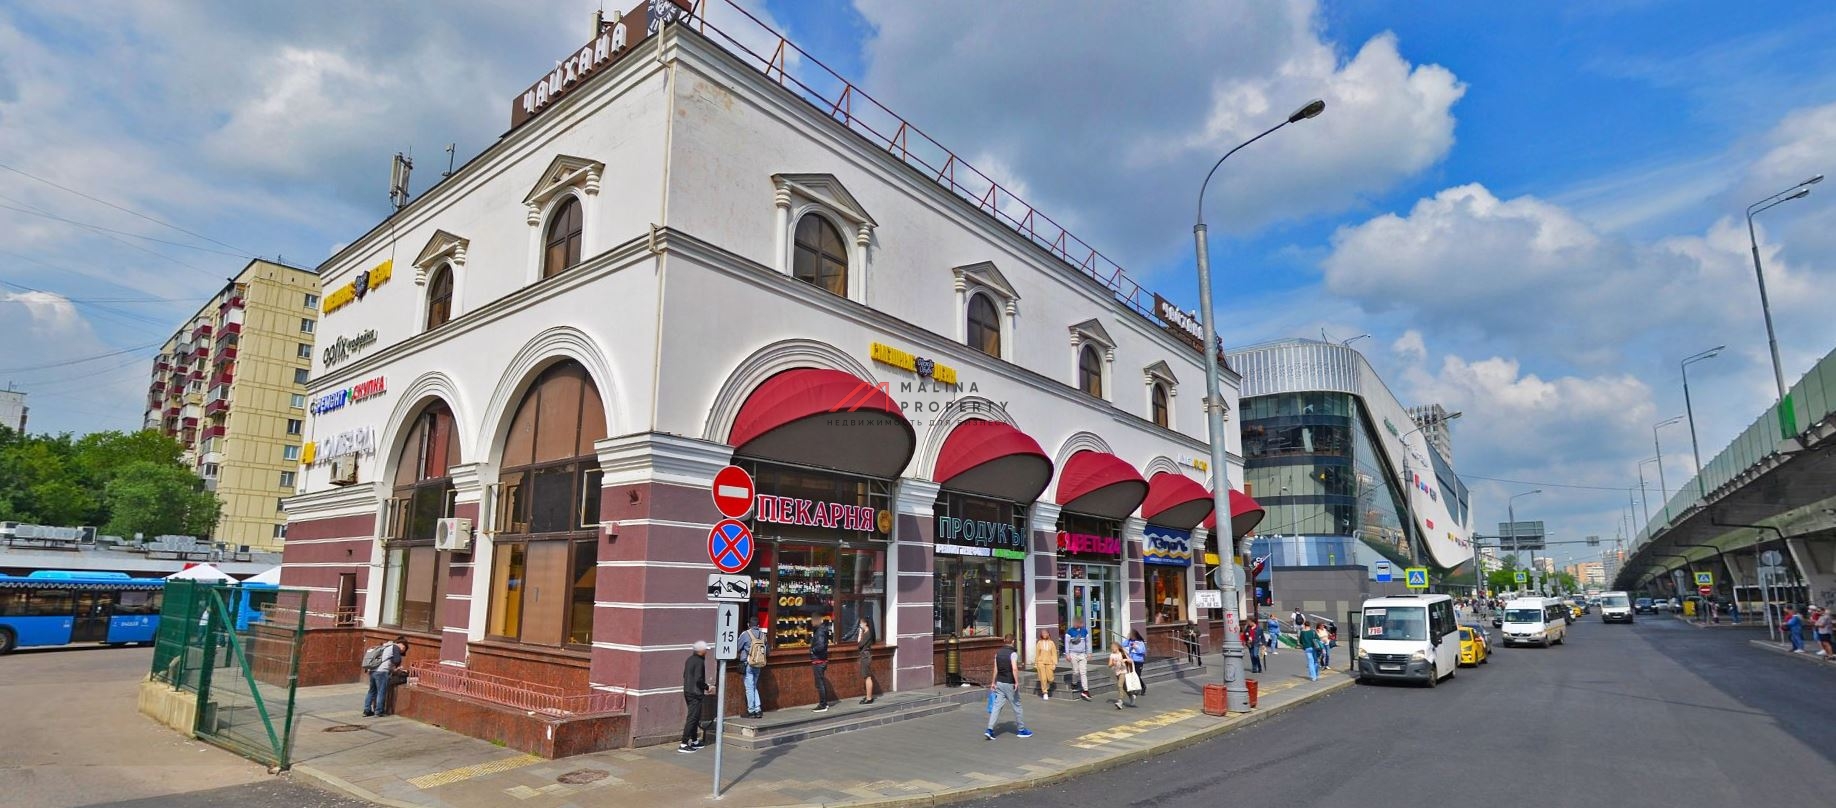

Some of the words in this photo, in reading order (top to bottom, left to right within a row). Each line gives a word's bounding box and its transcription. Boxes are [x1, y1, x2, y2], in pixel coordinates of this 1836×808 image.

[523, 22, 627, 114] ЧАЙХАНА
[1162, 302, 1204, 341] ЧАЙХАНА
[316, 389, 347, 413] РЕМОНТ
[352, 375, 385, 401] СКУПКА
[757, 493, 875, 532] ПЕКАРНЯ
[721, 631, 734, 642] 15
